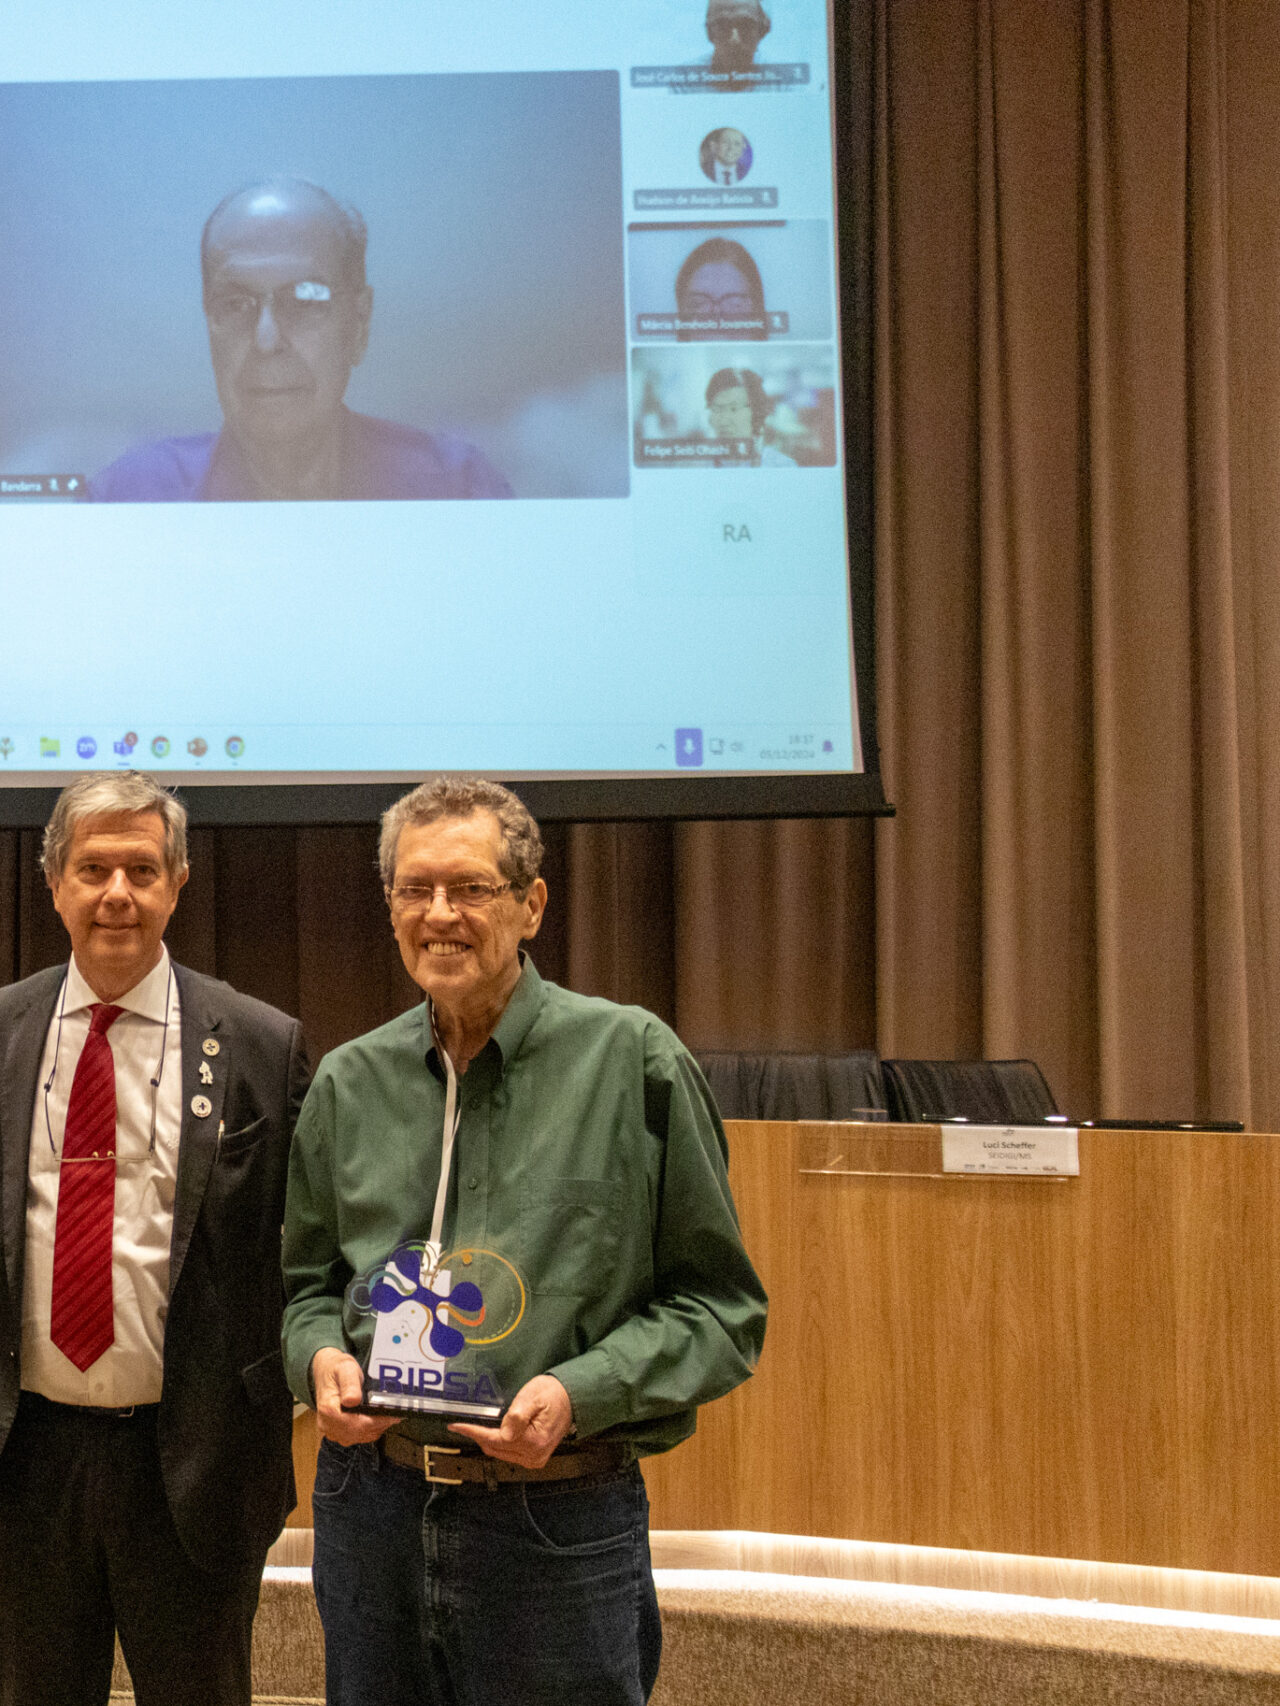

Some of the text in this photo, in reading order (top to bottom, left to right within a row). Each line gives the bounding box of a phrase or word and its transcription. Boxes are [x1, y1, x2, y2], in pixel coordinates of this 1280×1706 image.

[723, 524, 753, 543] RA
[983, 1141, 1000, 1149] Luci
[378, 1364, 499, 1398] RIPSA
